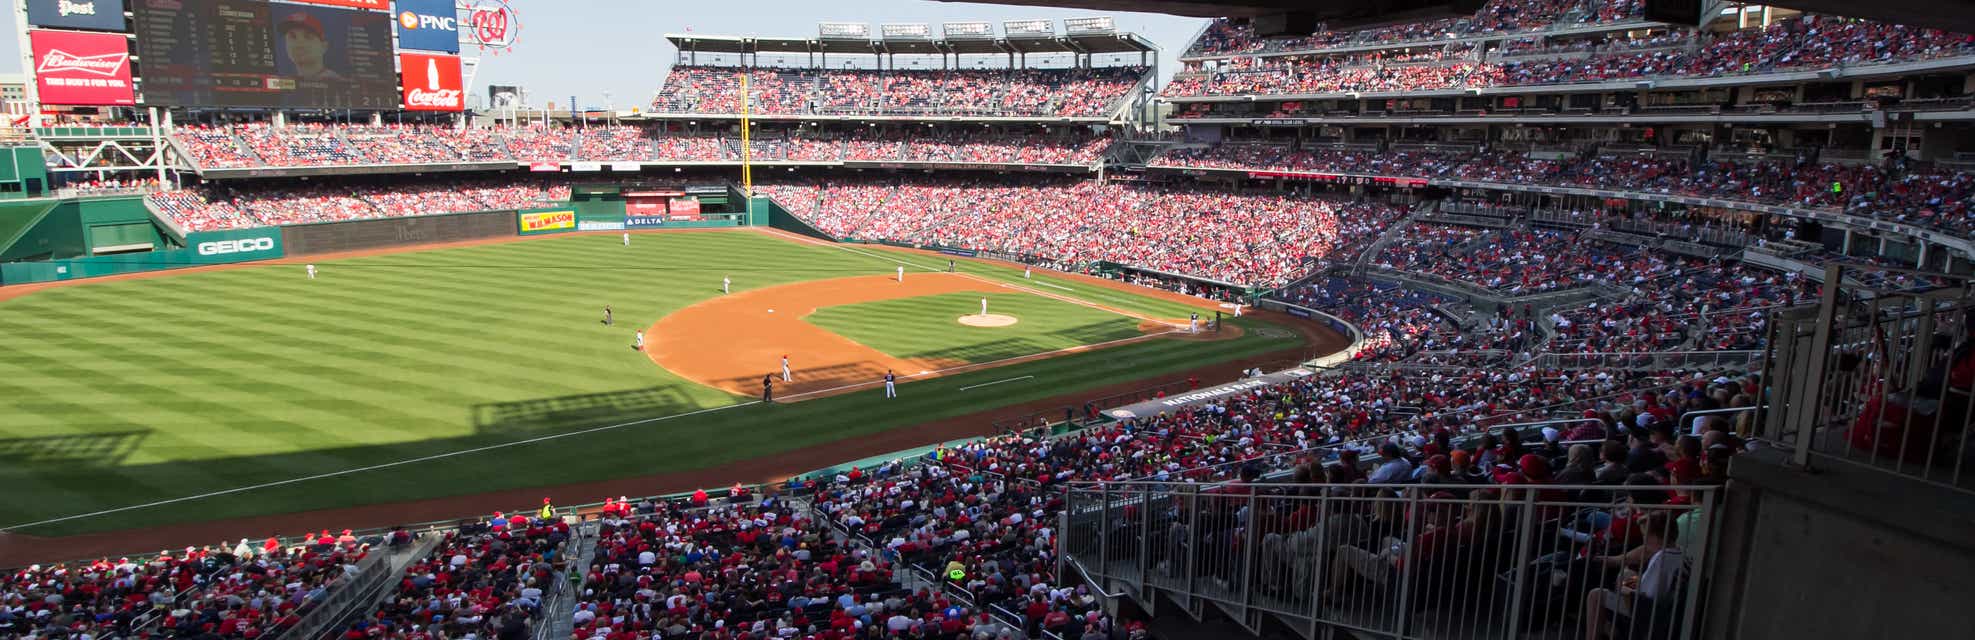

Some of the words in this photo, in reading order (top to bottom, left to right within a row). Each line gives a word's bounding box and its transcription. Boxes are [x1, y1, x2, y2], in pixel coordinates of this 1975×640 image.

[59, 0, 96, 16] Post
[418, 14, 456, 31] PNC
[43, 54, 121, 69] Budweiser
[91, 79, 107, 87] FOR
[407, 88, 462, 107] Coca-Cola
[198, 237, 274, 255] GEICO
[1162, 387, 1236, 406] NATIONALS
